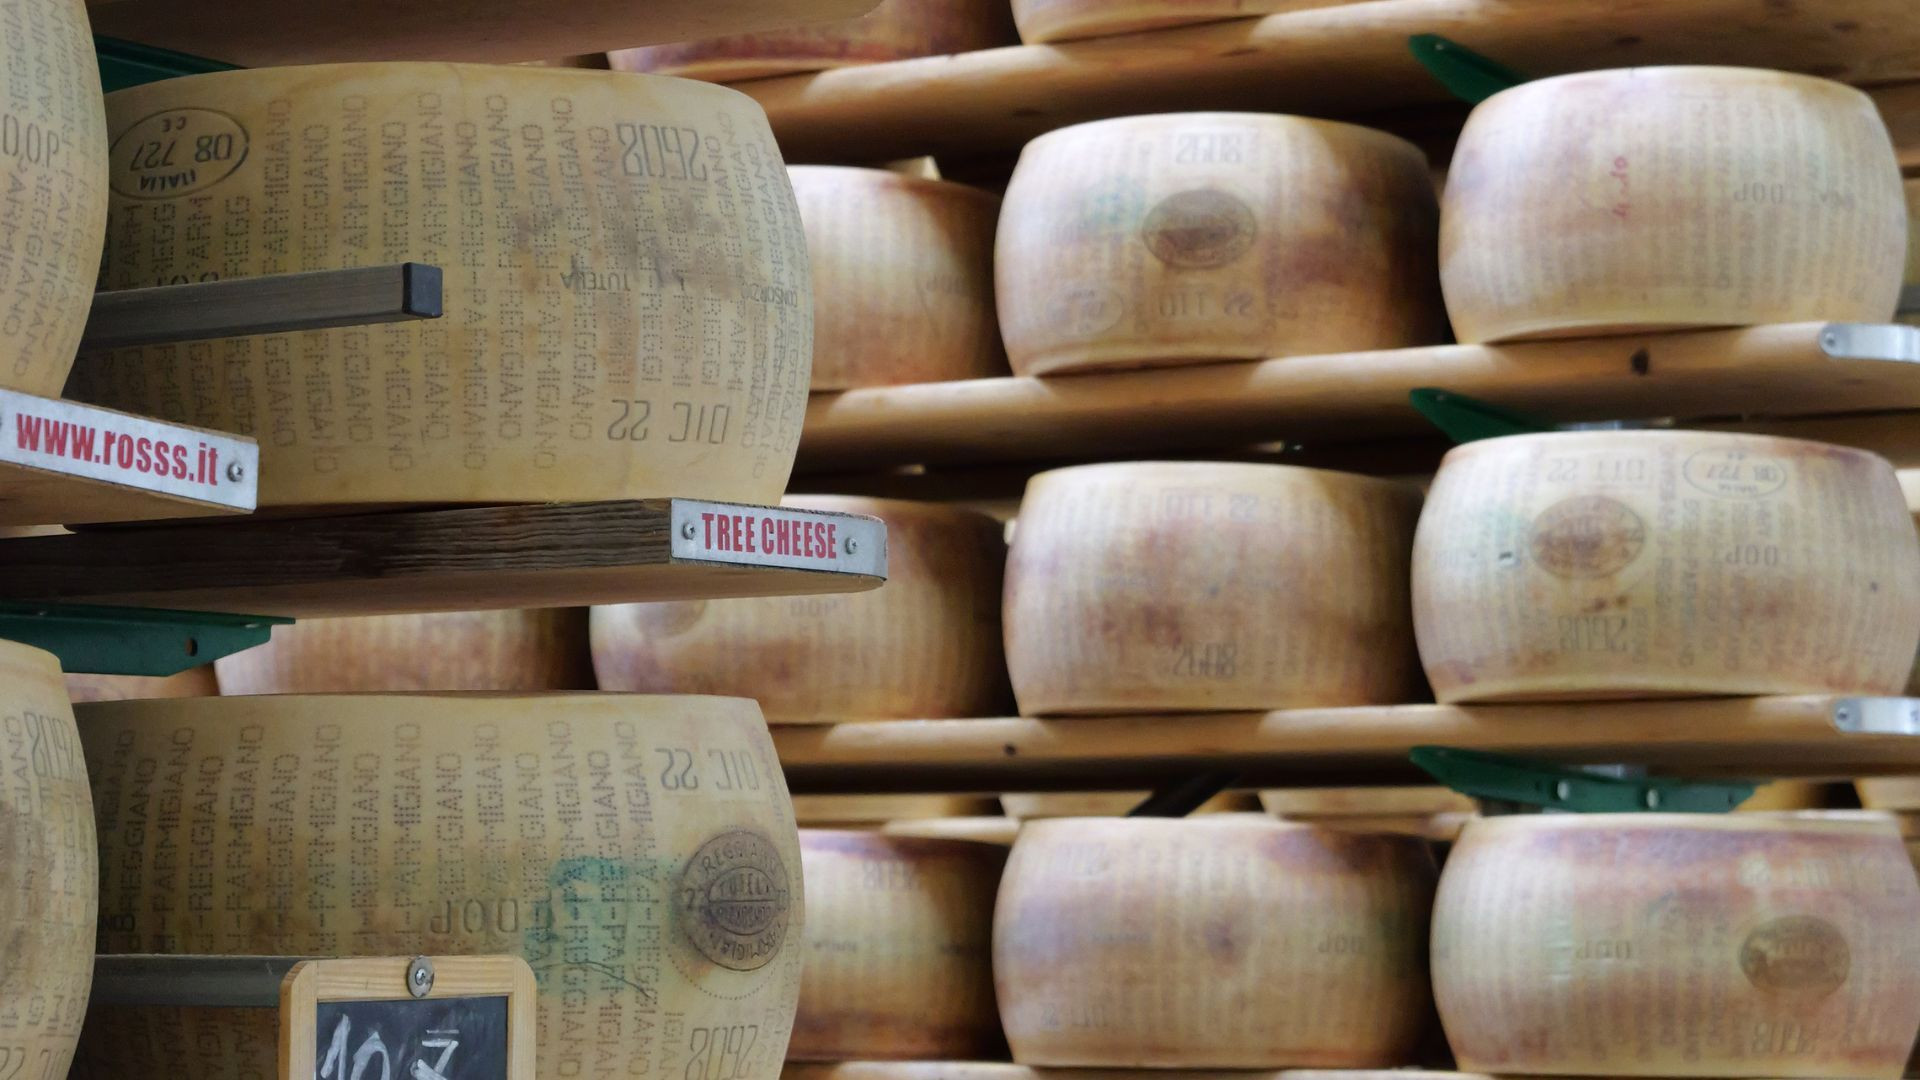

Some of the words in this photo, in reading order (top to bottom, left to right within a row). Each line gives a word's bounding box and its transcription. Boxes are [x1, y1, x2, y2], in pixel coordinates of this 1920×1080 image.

[3, 113, 60, 168] DOP
[129, 140, 177, 172] 727
[194, 132, 233, 163] 08
[140, 168, 197, 192] ITALIA
[455, 121, 487, 268] REGGIANO
[559, 270, 632, 292] TUTELA
[463, 288, 489, 471] PARMIGIANO
[498, 289, 525, 441] REGGIANO
[607, 399, 649, 441] 22
[667, 401, 730, 444] DIC
[16, 412, 218, 486] www.rosss.it
[702, 512, 756, 553] TREE
[761, 517, 837, 560] CHEESE
[654, 747, 700, 792] 22
[707, 749, 762, 792] DIC
[308, 723, 342, 910] PARMIGIANO
[393, 722, 422, 908] PARMIGIANO
